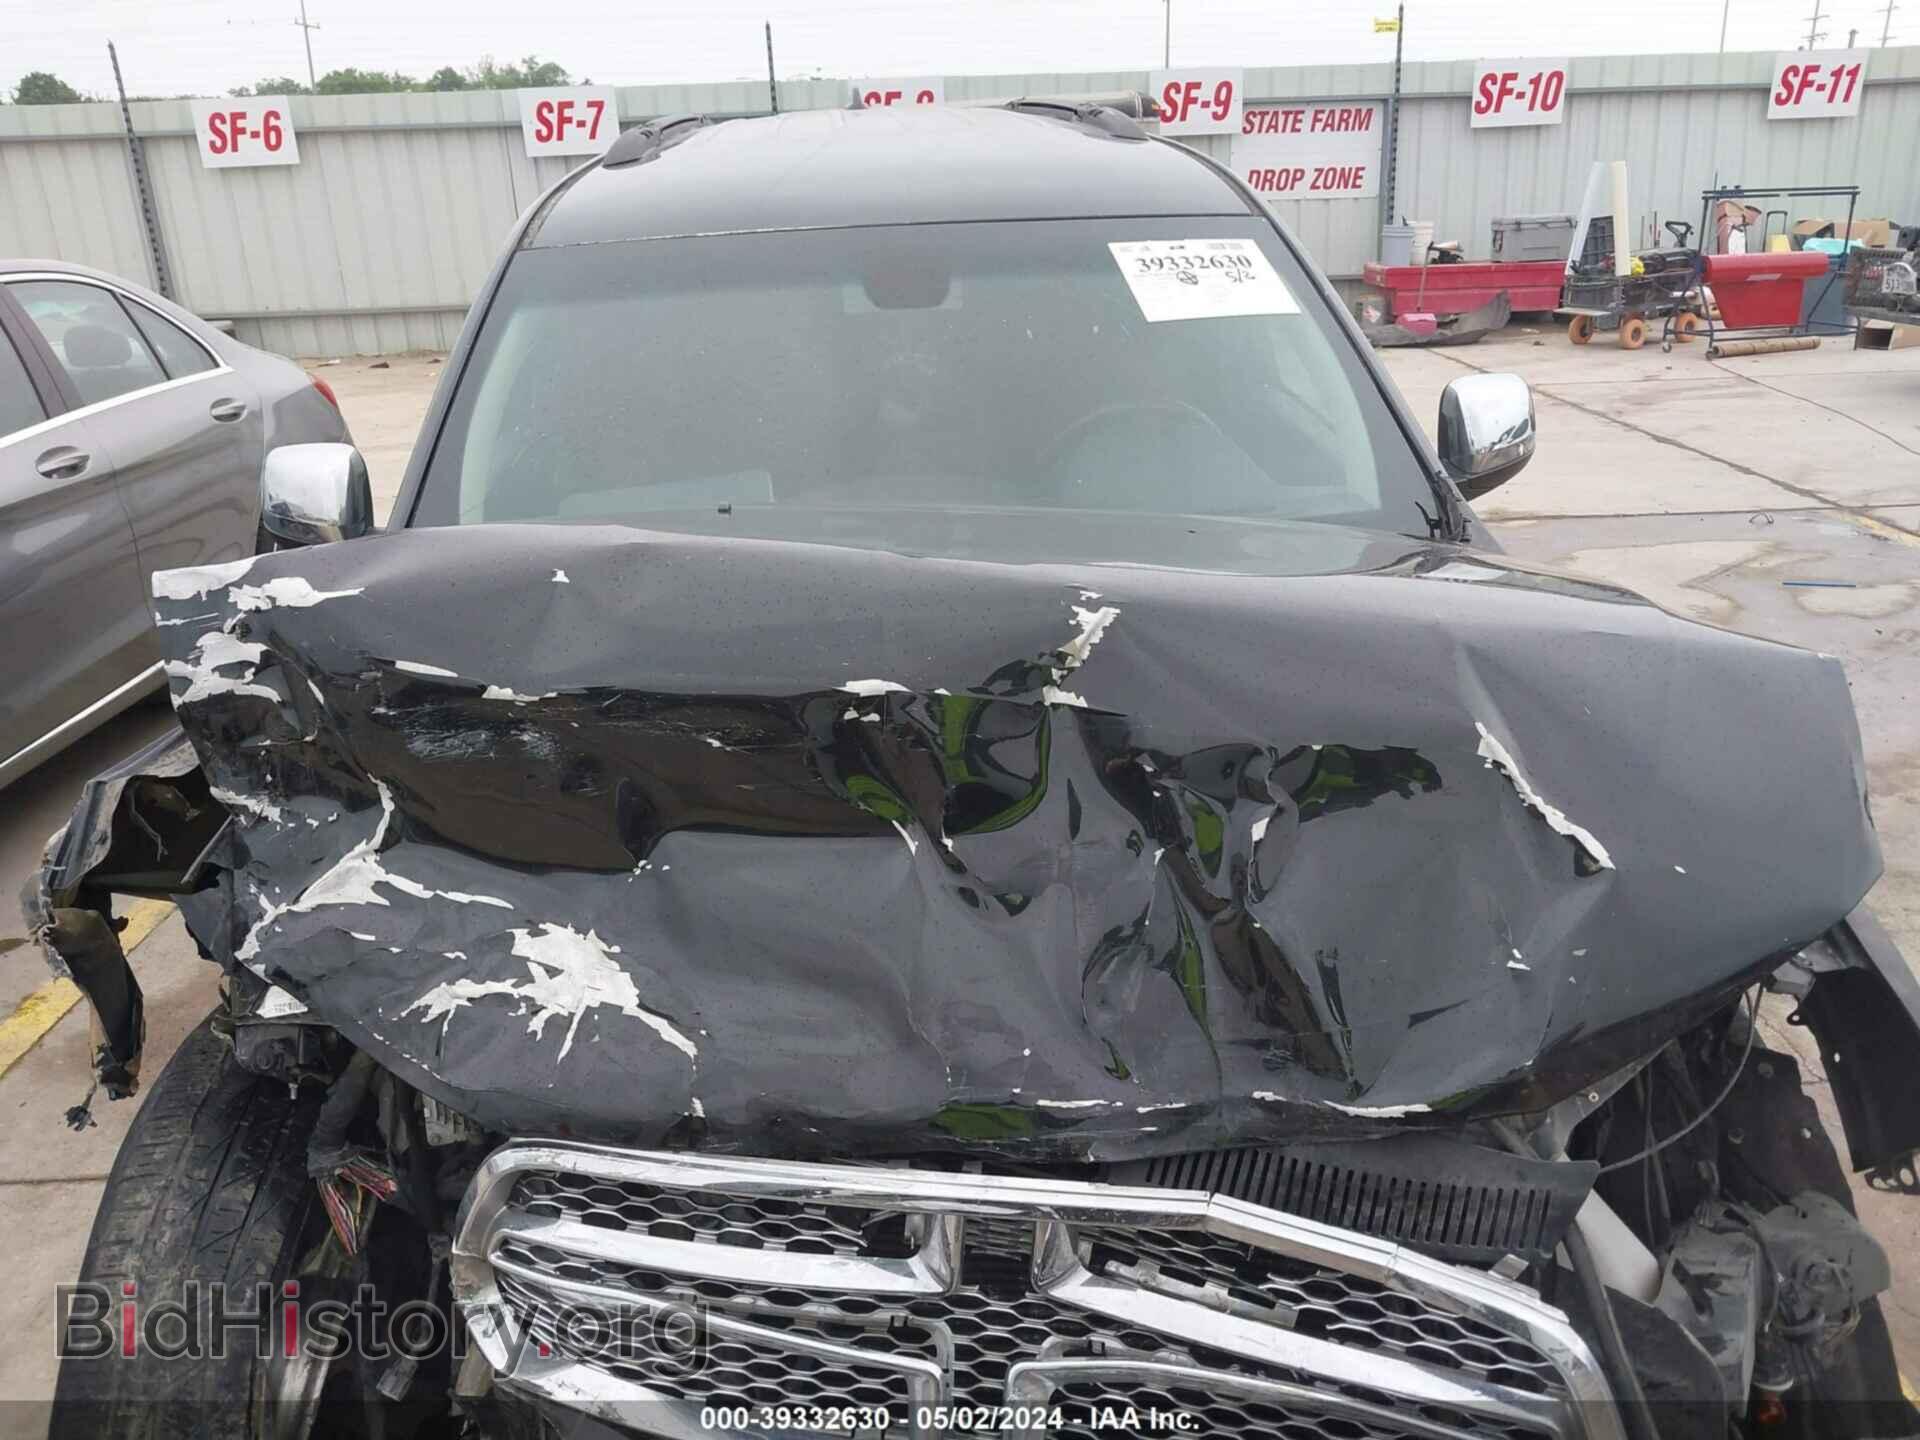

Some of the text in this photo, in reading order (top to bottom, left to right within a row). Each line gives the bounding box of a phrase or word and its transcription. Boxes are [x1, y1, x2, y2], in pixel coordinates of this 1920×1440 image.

[1160, 80, 1233, 124] SF-9
[1474, 69, 1566, 116] SF-10
[1774, 63, 1861, 107] SF-11
[207, 110, 284, 155] SF-6
[534, 99, 605, 144] SF-7
[1242, 107, 1374, 135] STATE FARM
[1248, 166, 1366, 192] DROP ZONE
[1134, 253, 1253, 273] 39332630
